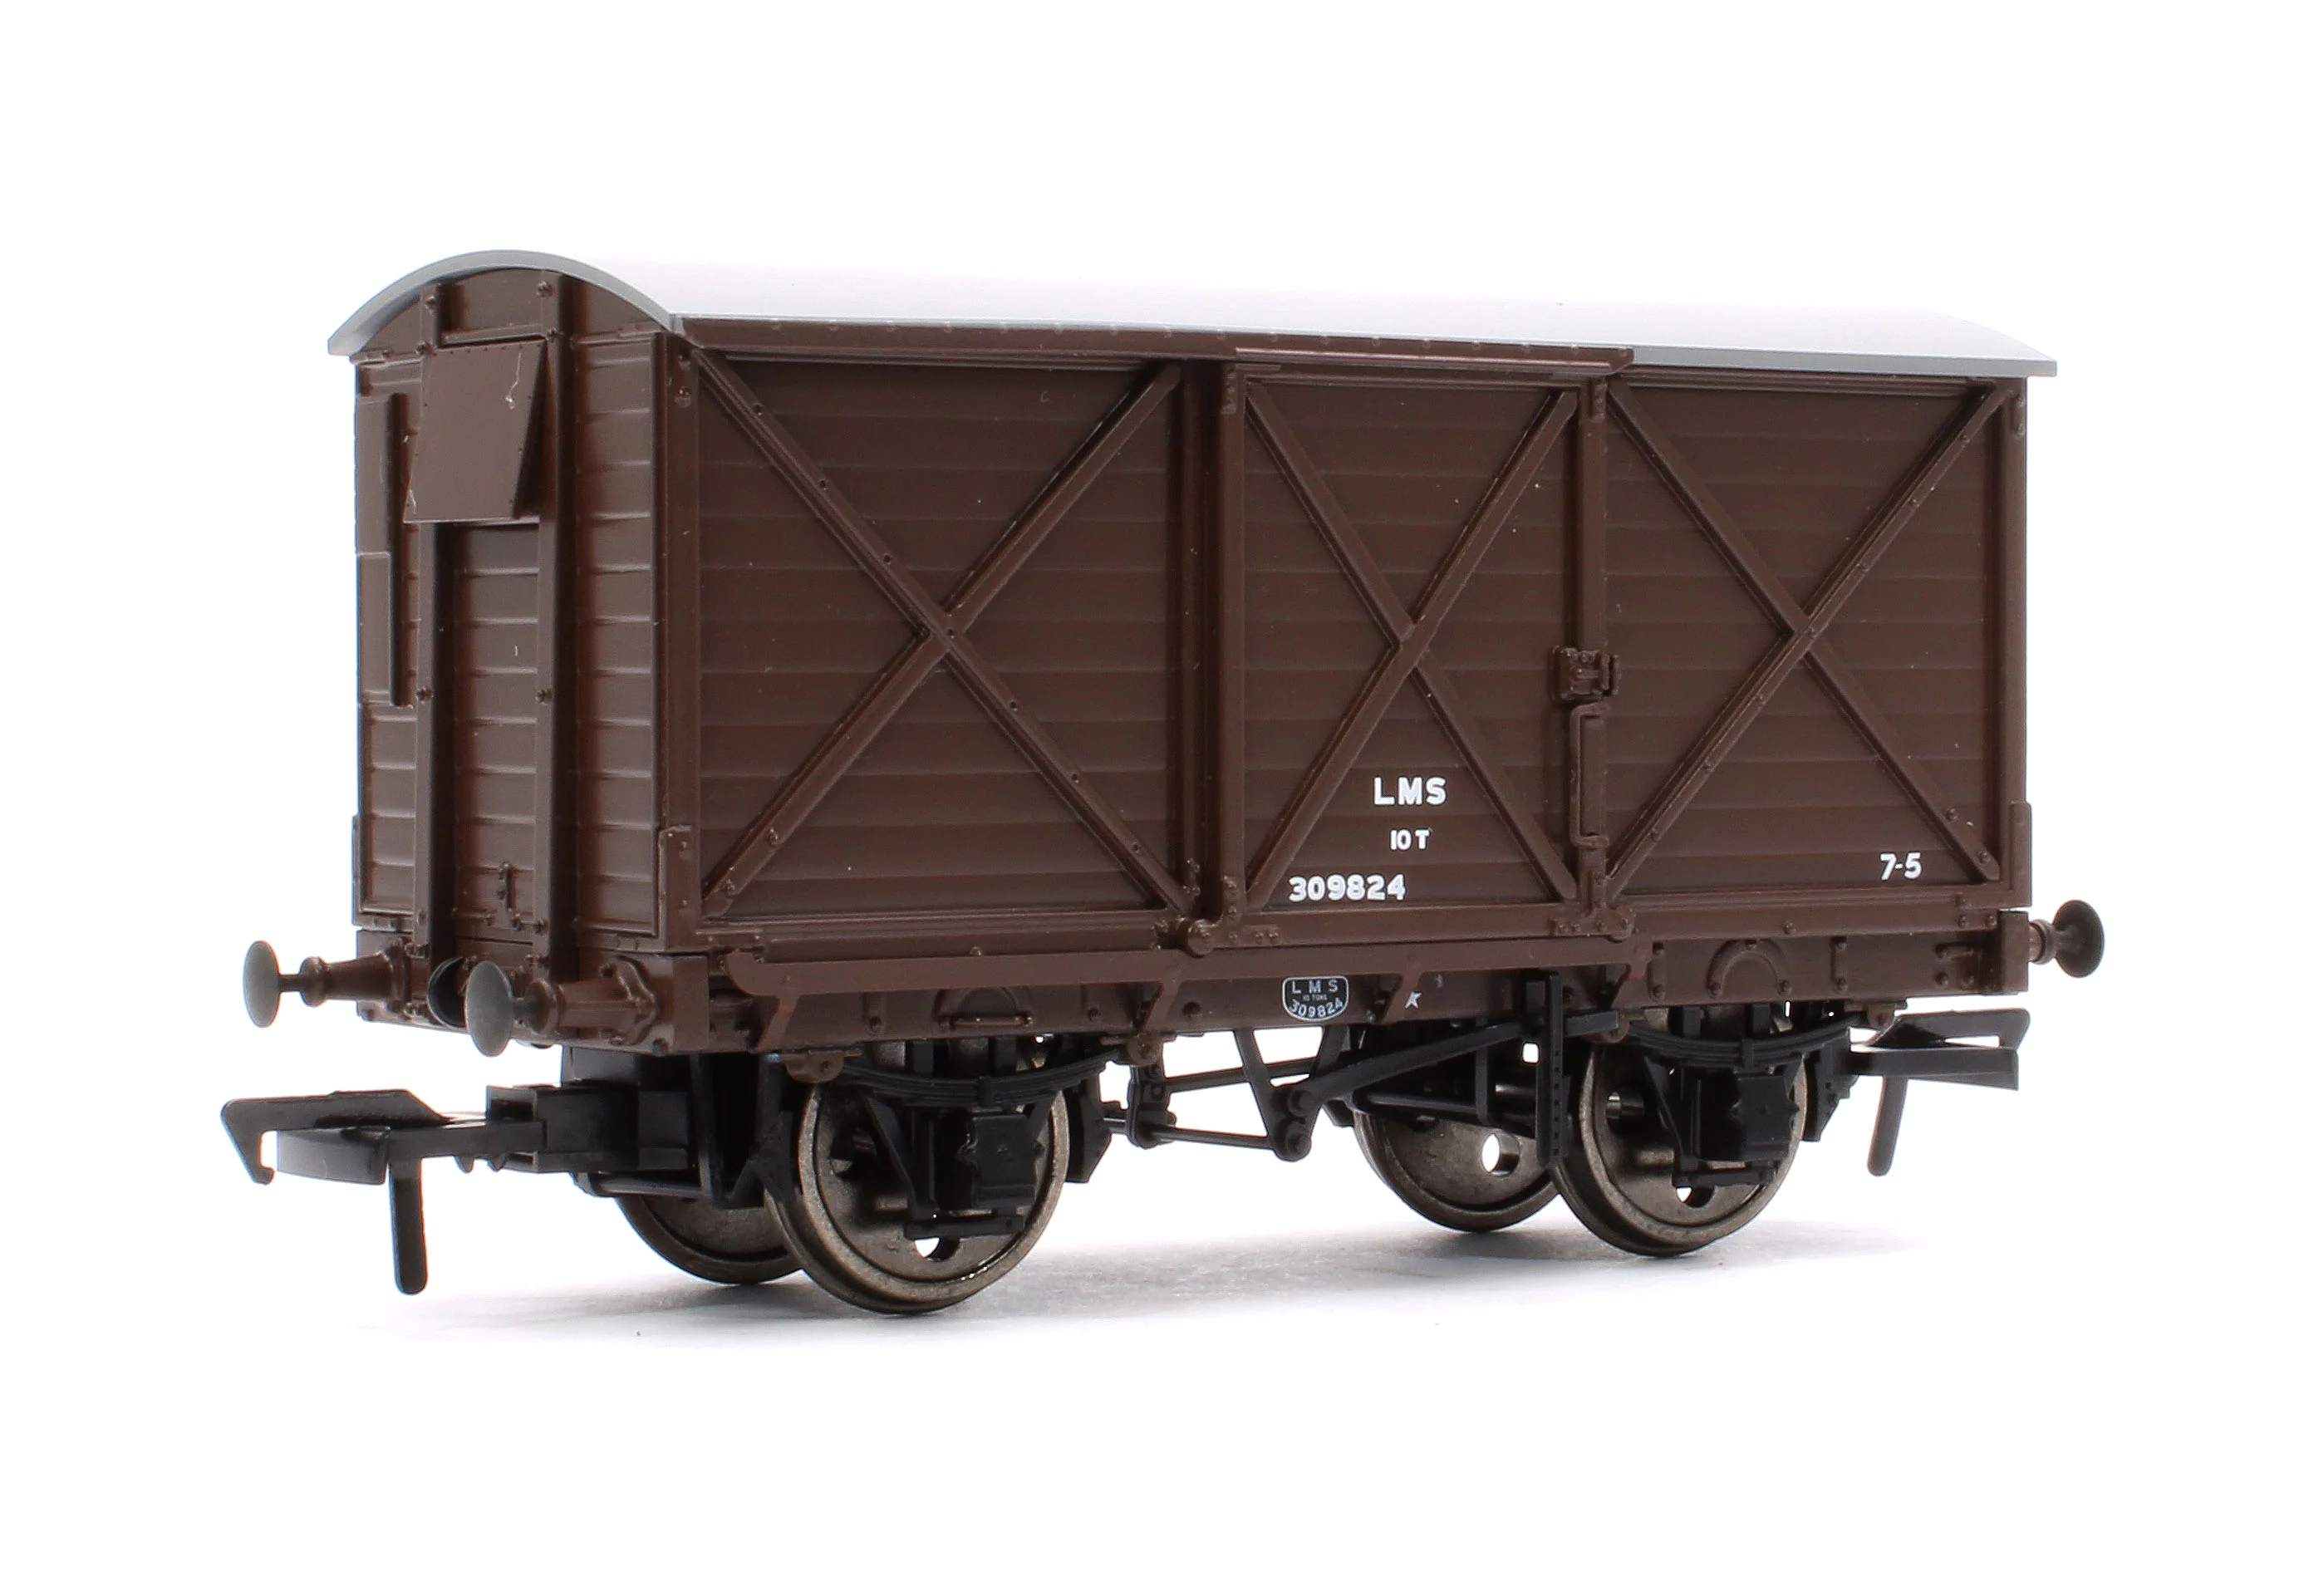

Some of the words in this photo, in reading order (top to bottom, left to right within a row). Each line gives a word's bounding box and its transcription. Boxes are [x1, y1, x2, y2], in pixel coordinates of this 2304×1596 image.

[1373, 776, 1447, 806] LMS
[1879, 852, 1923, 881] 7-5
[1289, 874, 1407, 901] 309824
[1289, 997, 1344, 1018] 309824
